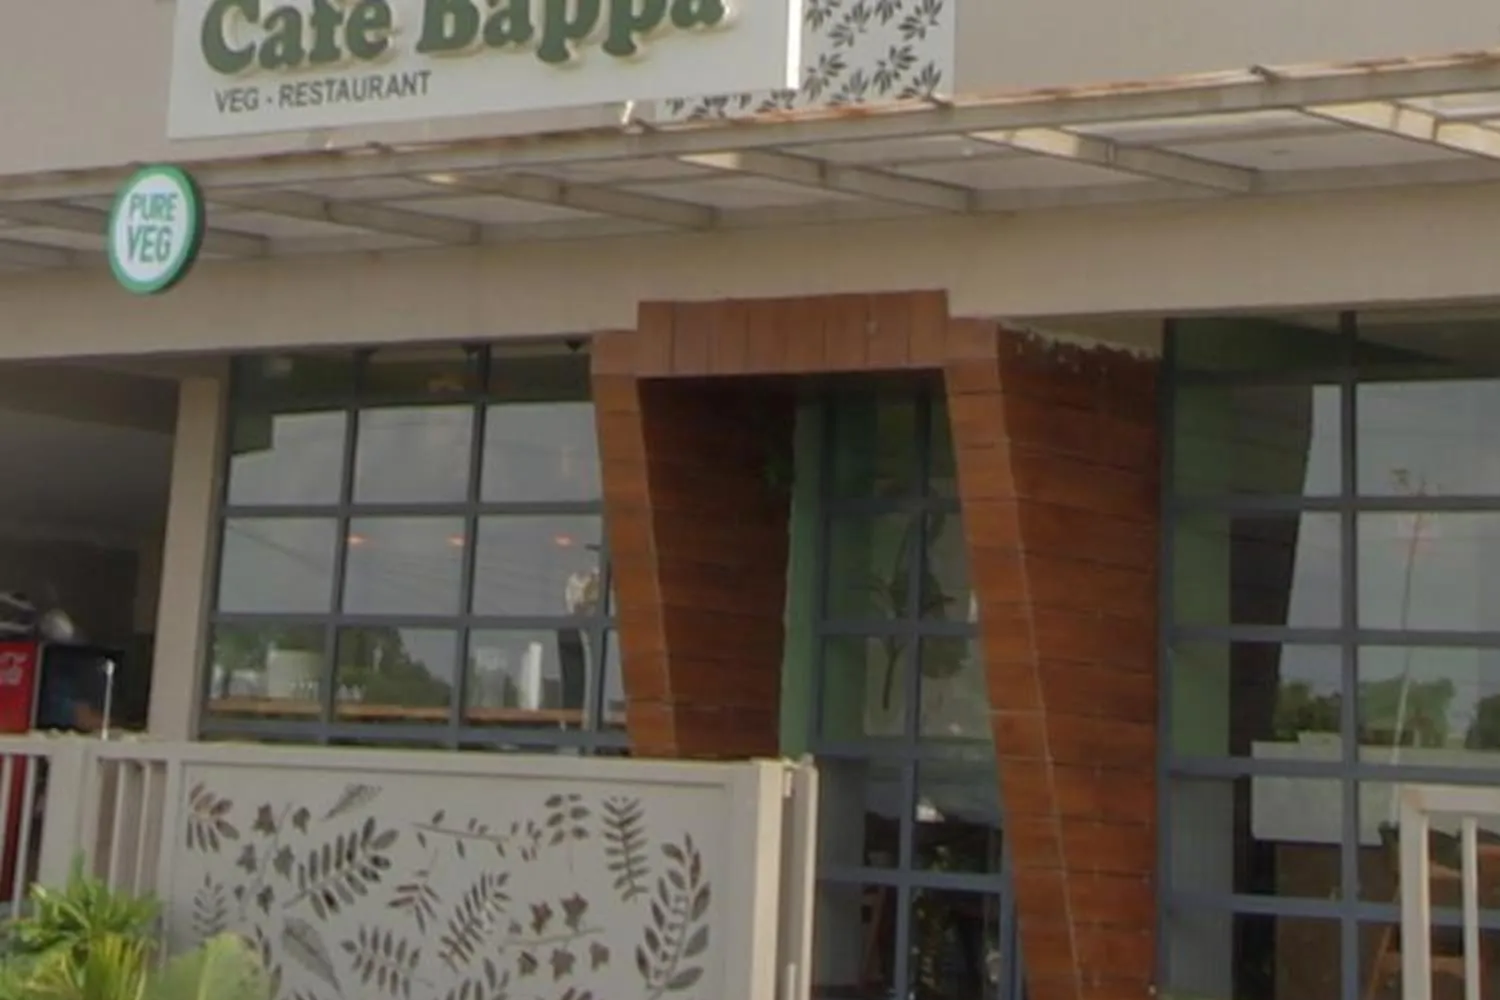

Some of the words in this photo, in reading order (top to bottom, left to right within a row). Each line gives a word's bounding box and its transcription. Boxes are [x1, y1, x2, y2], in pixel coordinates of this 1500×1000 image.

[215, 87, 259, 113] VEG
[278, 70, 431, 108] RESTAURANT
[130, 192, 178, 221] PURE
[128, 225, 173, 262] VEG
